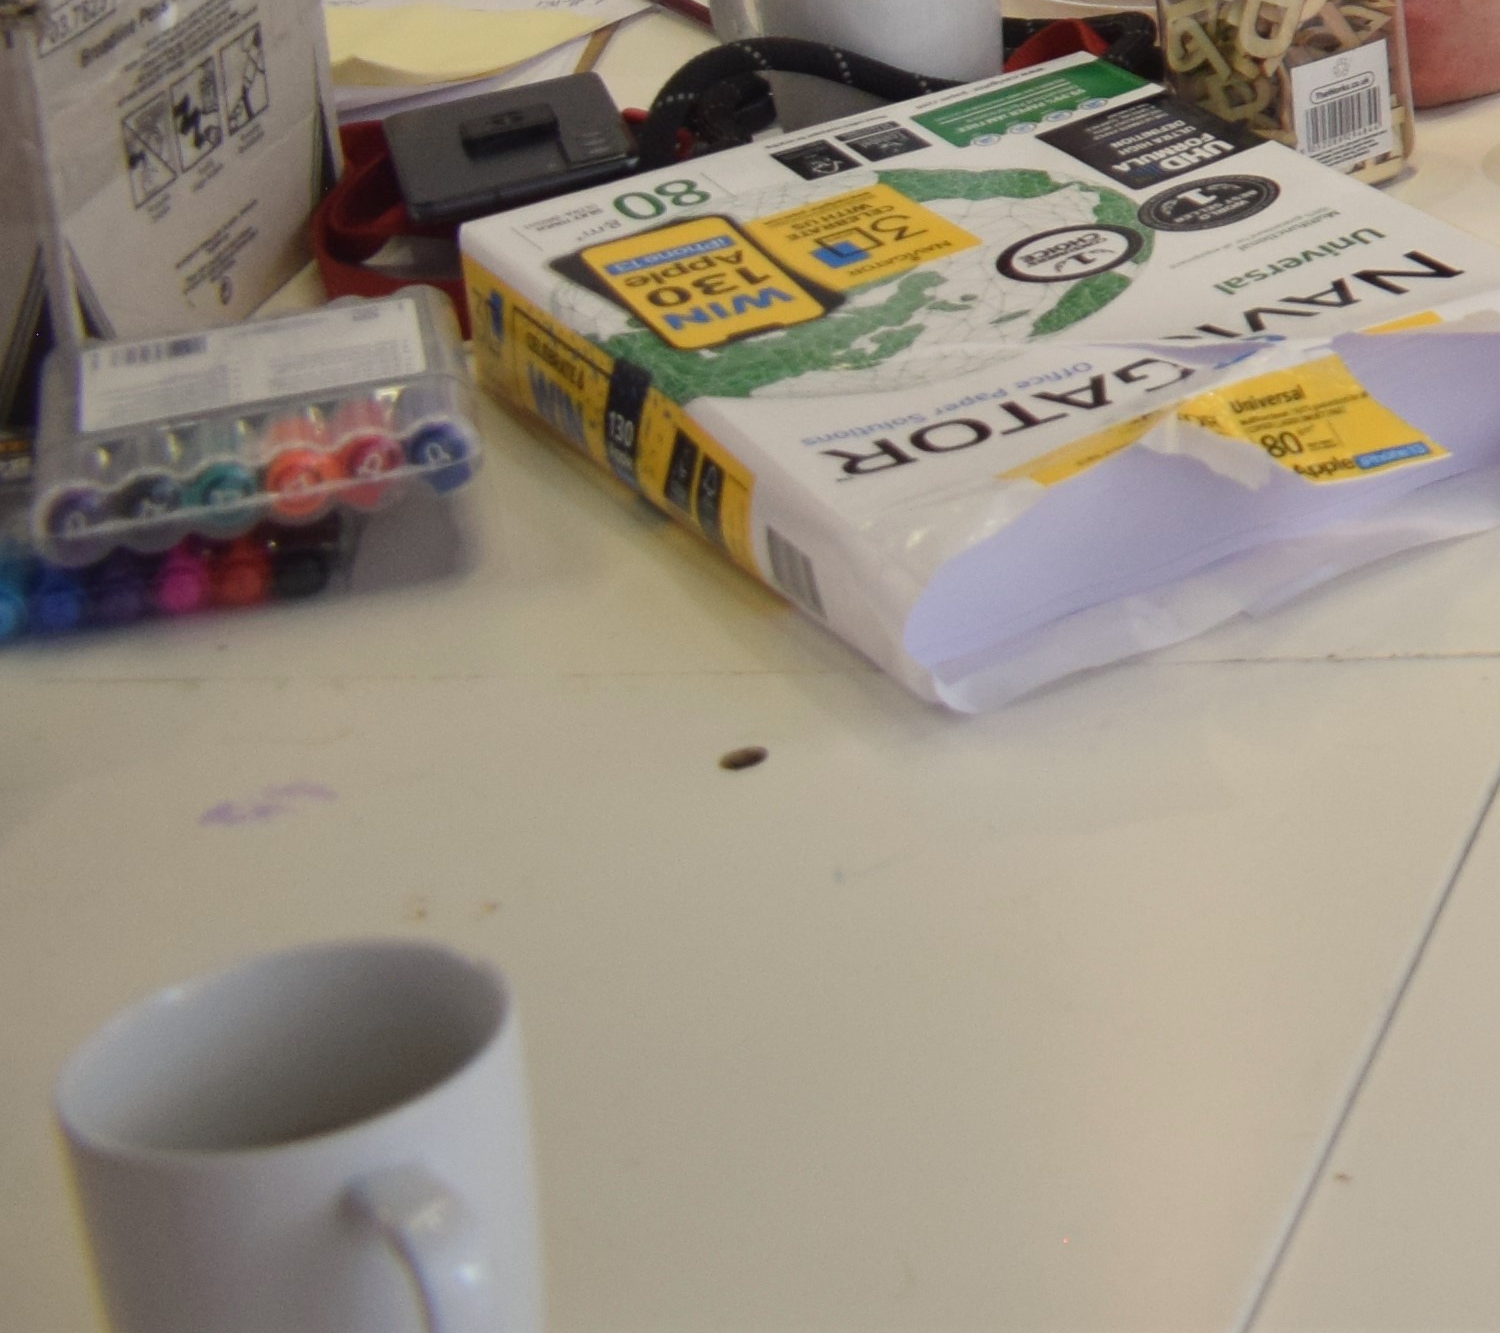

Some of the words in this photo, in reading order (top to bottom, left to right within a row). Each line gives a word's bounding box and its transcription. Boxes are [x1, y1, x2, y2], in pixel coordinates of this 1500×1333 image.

[1109, 120, 1187, 150] DEFINITION
[1118, 139, 1157, 156] HIGH
[1152, 126, 1197, 148] ULTRA
[1111, 132, 1217, 173] FORMULA
[1159, 140, 1236, 171] UHD
[612, 178, 712, 221] 80
[785, 204, 895, 241] CELEBRATE
[1018, 232, 1102, 264] CHOICE
[1212, 226, 1388, 296] Universal
[624, 250, 746, 289] Apple
[644, 271, 773, 308] 130
[660, 287, 796, 331] WIN
[1015, 361, 1094, 392] Office
[935, 387, 1009, 418] Paper
[1230, 384, 1308, 414] Universal
[800, 412, 927, 447] Solutions
[1260, 430, 1304, 458] 80
[1293, 455, 1356, 478] Apple
